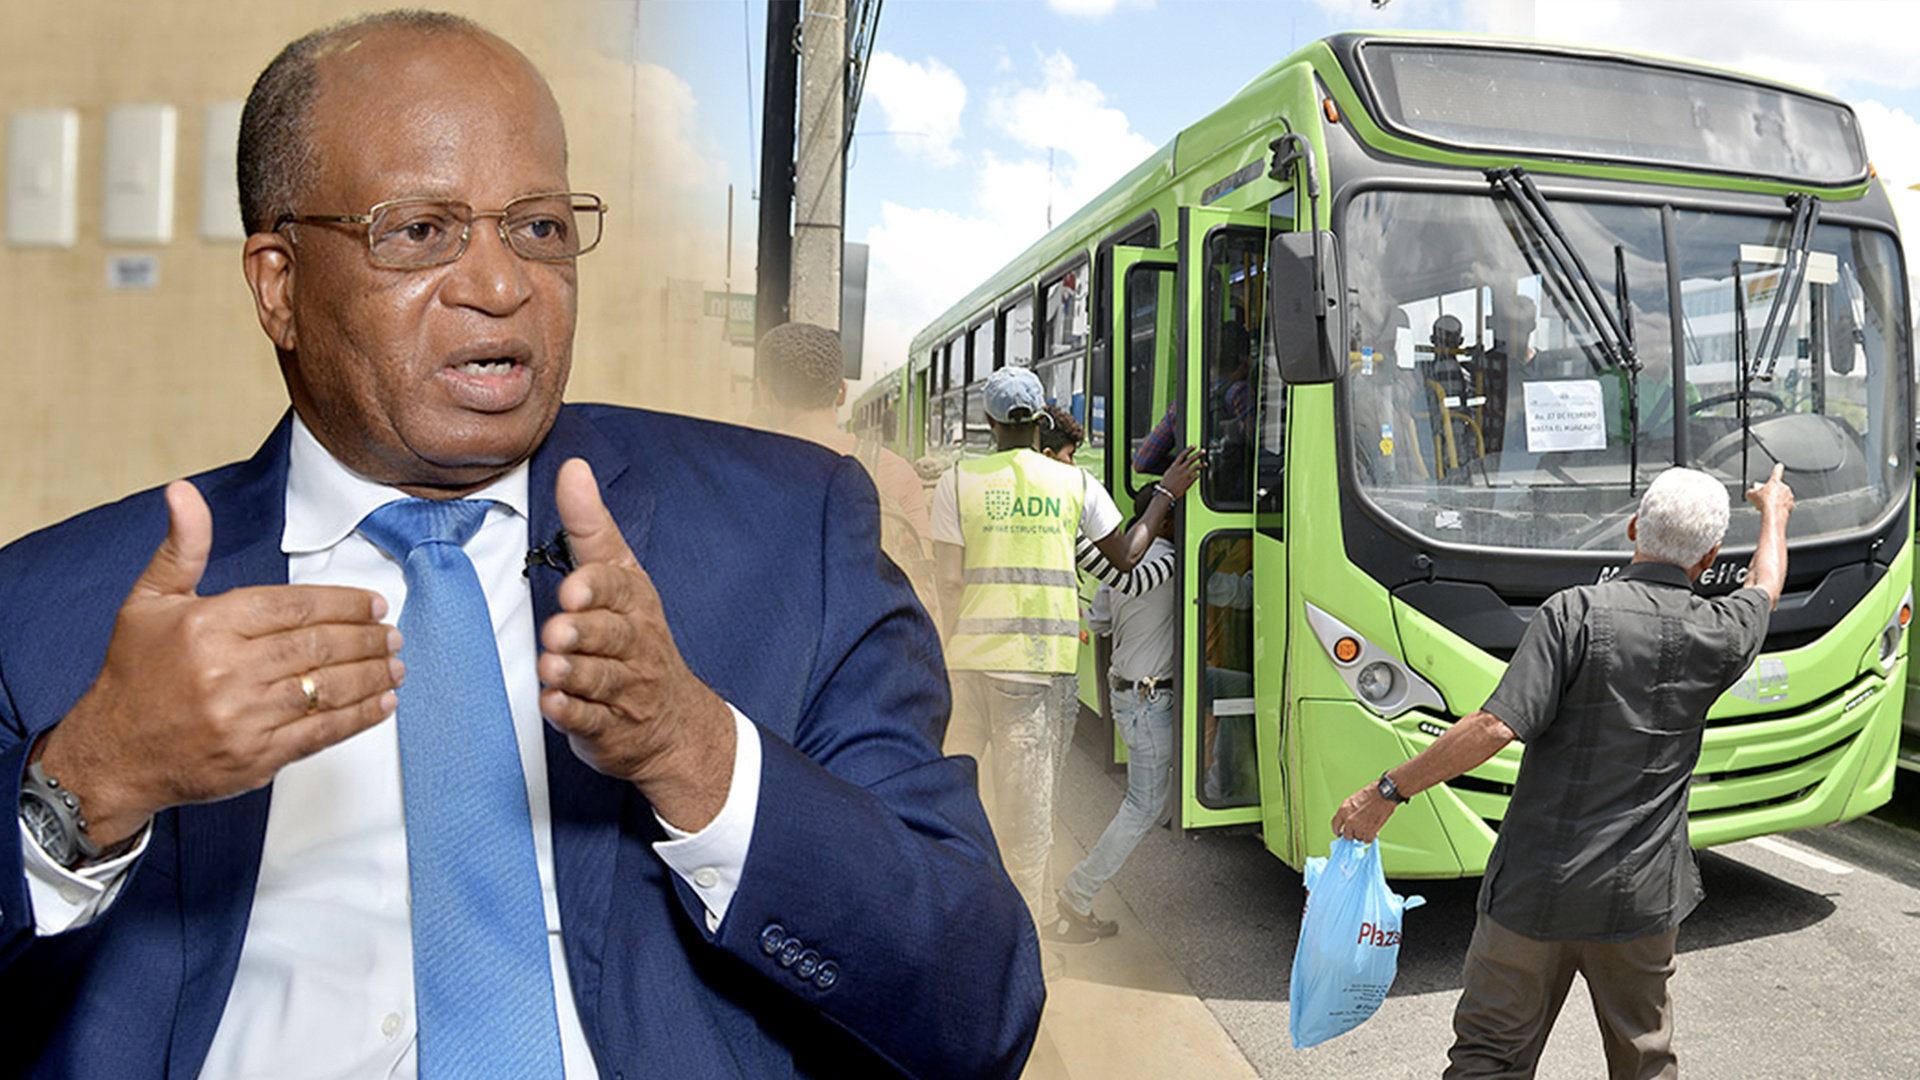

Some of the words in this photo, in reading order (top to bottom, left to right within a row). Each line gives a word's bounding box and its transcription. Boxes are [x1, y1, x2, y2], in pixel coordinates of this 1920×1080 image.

[1547, 412, 1555, 420] 27
[1557, 412, 1566, 420] DE
[1010, 497, 1060, 518] ADN
[1358, 922, 1402, 946] Plaza
